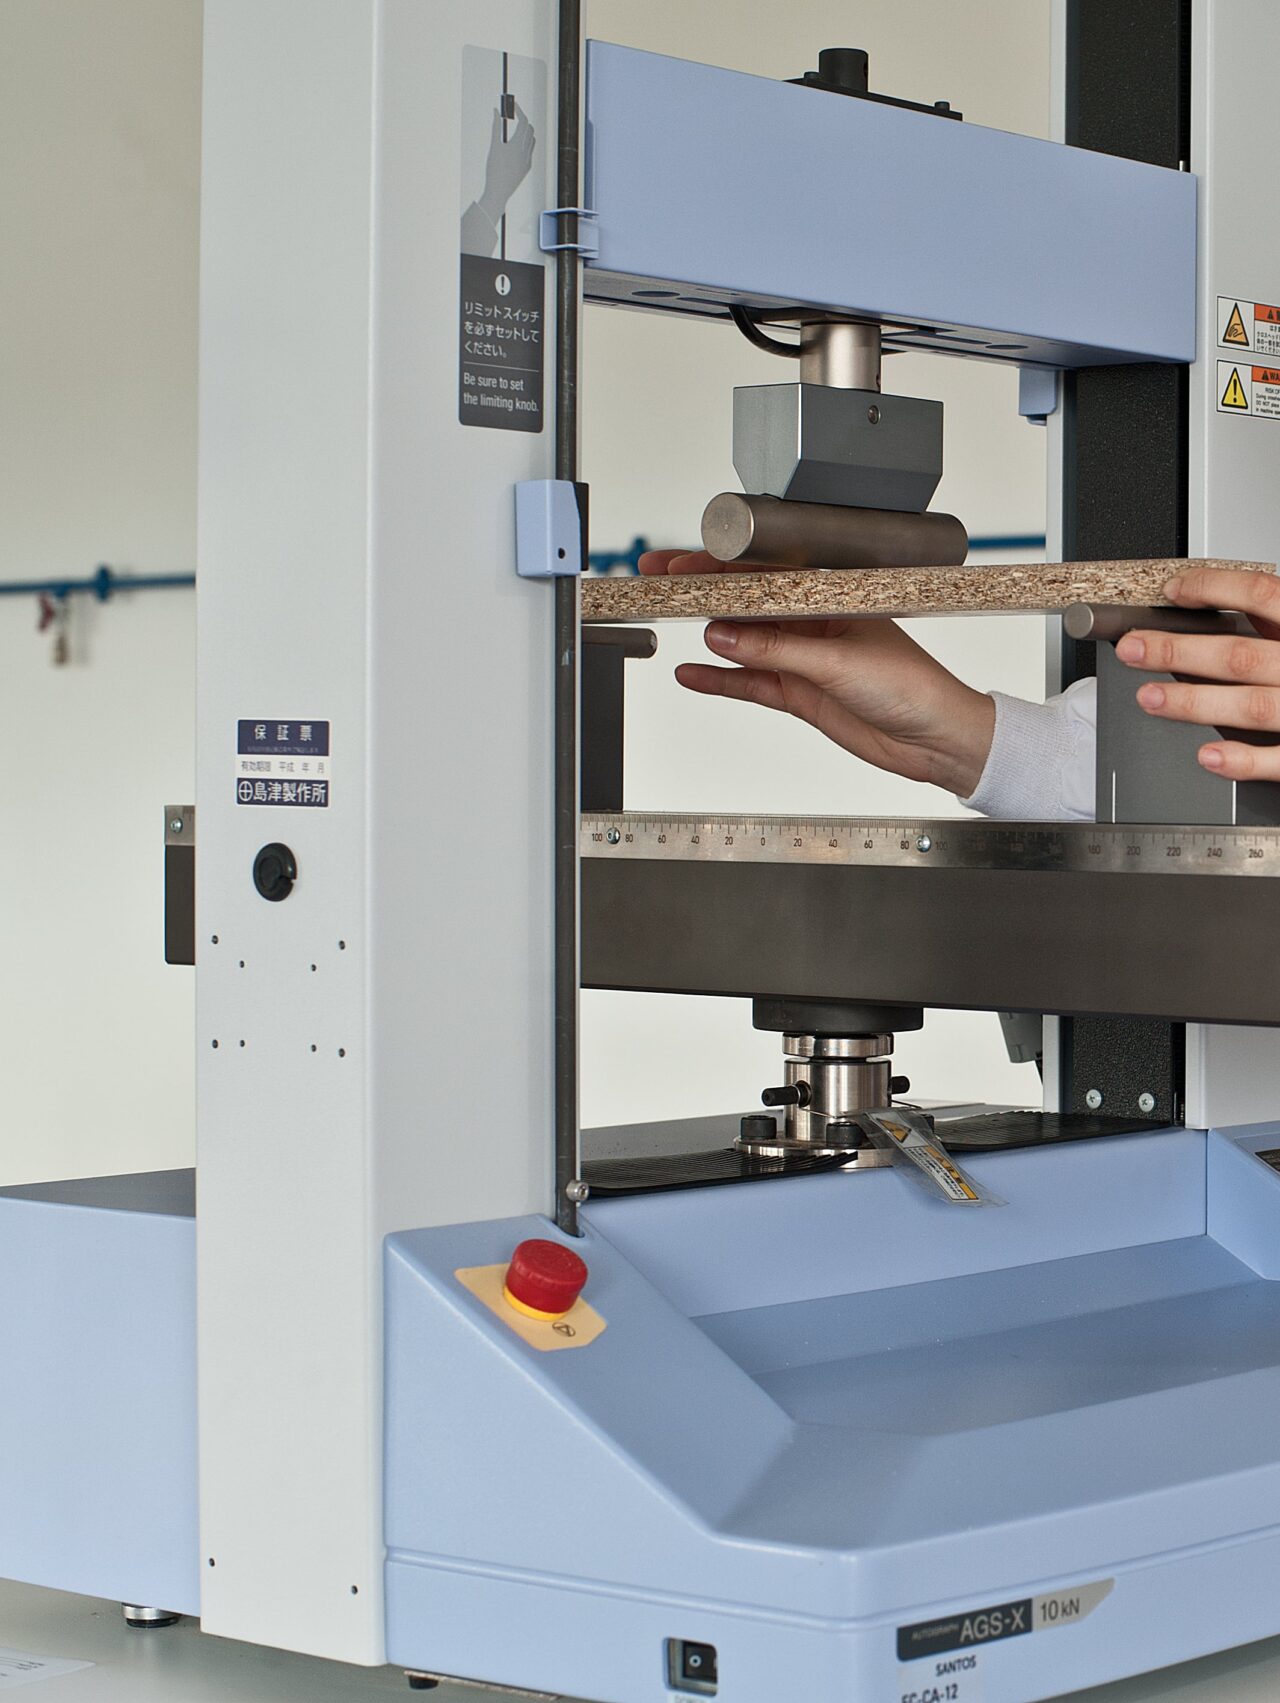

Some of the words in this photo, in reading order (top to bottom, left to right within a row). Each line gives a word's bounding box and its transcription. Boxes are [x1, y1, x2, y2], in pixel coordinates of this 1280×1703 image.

[465, 301, 539, 322] リミットスイッチ
[464, 321, 539, 343] を必ずセットして
[464, 340, 507, 358] ください。
[464, 372, 476, 385] Be
[478, 376, 497, 388] sure
[499, 376, 508, 389] to
[510, 379, 524, 391] set
[463, 392, 478, 405] the
[480, 393, 514, 412] limiting
[515, 397, 539, 412] knob.
[253, 781, 326, 803] 島津製作所
[592, 833, 602, 842] 100
[625, 834, 634, 843] 80
[658, 834, 666, 843] 60
[691, 835, 700, 844] 40
[724, 836, 734, 845] 20
[760, 837, 766, 846] 0
[793, 838, 802, 847] 20
[828, 839, 838, 848] 40
[864, 840, 873, 849] 60
[900, 840, 909, 849] 80
[1126, 846, 1141, 856] 200
[1166, 847, 1181, 857] 220
[1207, 848, 1222, 858] 240
[1248, 849, 1264, 859] 260
[959, 1606, 1025, 1642] AGS-X
[1040, 1602, 1058, 1621] 10
[1060, 1598, 1080, 1617] kN
[936, 1655, 976, 1677] SANTOS
